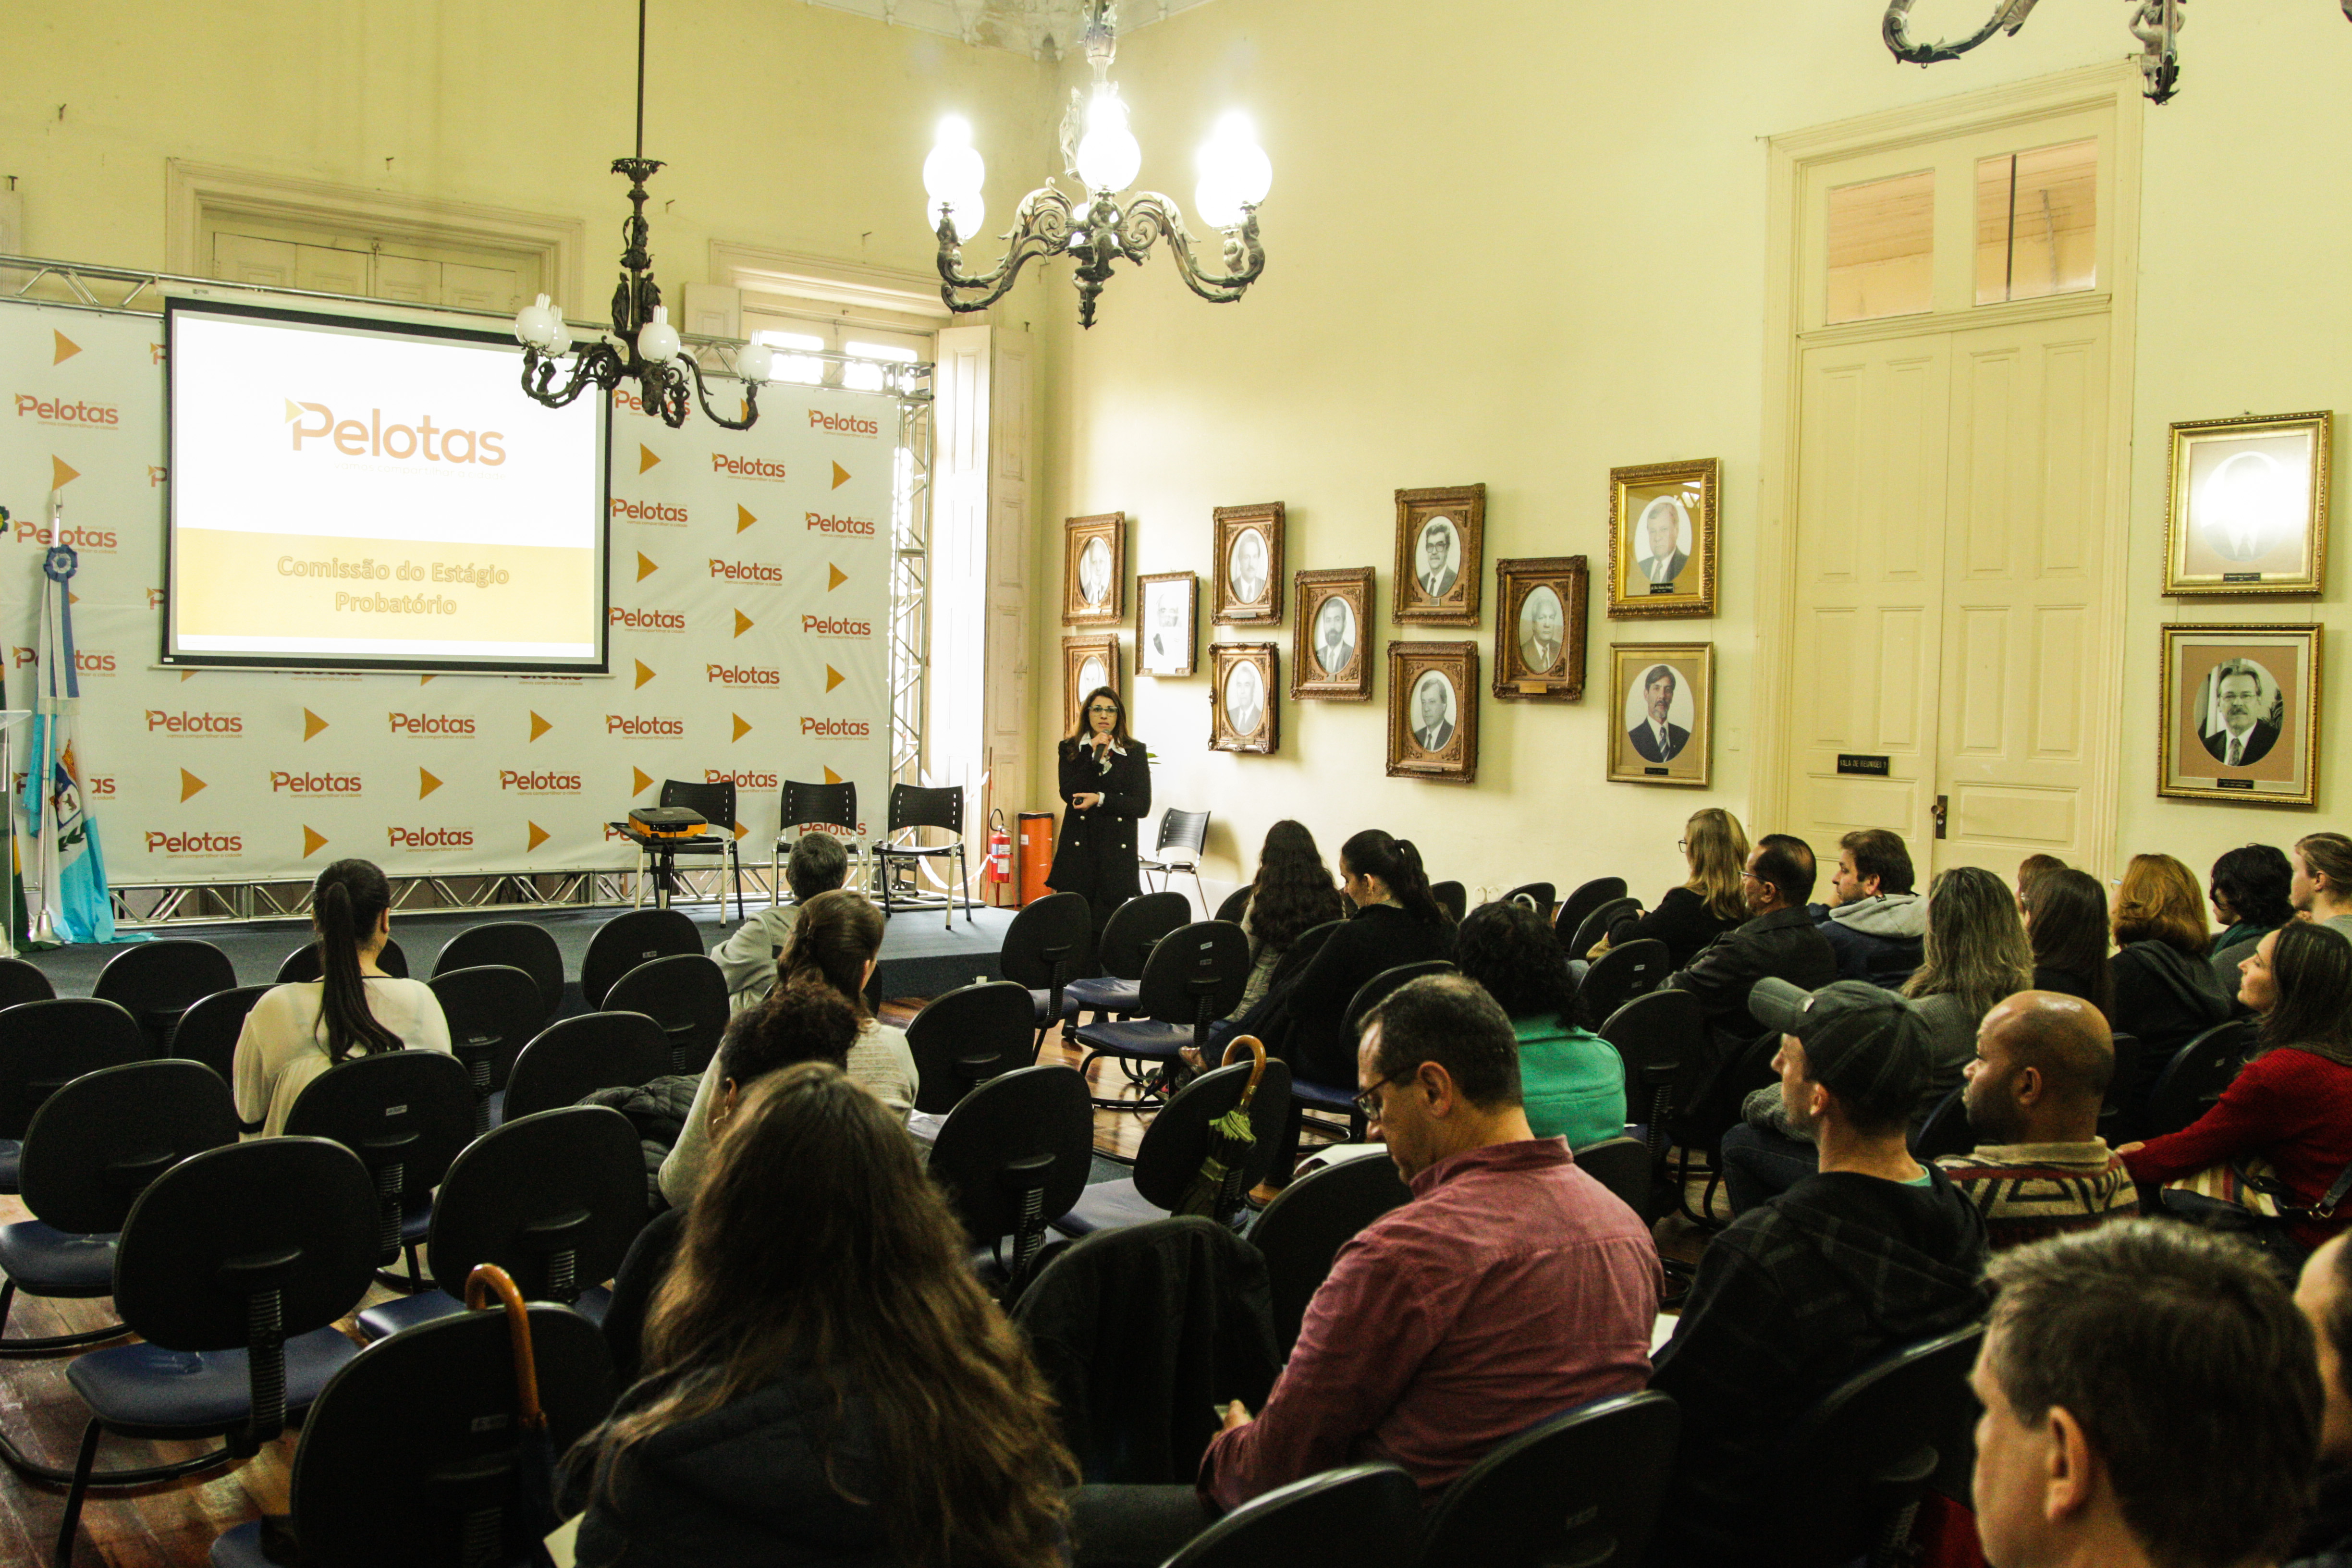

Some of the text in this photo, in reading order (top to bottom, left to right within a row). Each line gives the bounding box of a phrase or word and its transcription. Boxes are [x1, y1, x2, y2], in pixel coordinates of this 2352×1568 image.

[18, 395, 119, 425] Pelotas
[810, 410, 878, 434] Pelotas
[293, 402, 506, 466] Pelotas
[334, 462, 373, 471] vamos
[378, 465, 454, 477] compartilhar
[467, 471, 506, 480] cidade
[714, 454, 785, 478] Pelotas
[612, 499, 688, 522] Pelotas
[807, 513, 875, 535] Pelotas
[17, 522, 117, 548] Peotas
[277, 556, 509, 588] Comissão do Estágio
[711, 559, 783, 581] Pelotas
[336, 592, 456, 615] Probatório
[610, 607, 685, 628] Pelotas
[804, 615, 871, 635] Pelotas
[16, 647, 116, 671] Ptas
[709, 664, 780, 684] Pelotas
[149, 710, 243, 732] Pelotas
[392, 713, 476, 733] Pelotas
[608, 715, 684, 734] Pelotas
[802, 717, 870, 735] Pelotas
[273, 772, 362, 792] Pelotas
[502, 771, 582, 789] Pelotas
[707, 770, 778, 787] Pelotas
[148, 831, 242, 852] Pelotas
[391, 827, 474, 846] Pelotas
